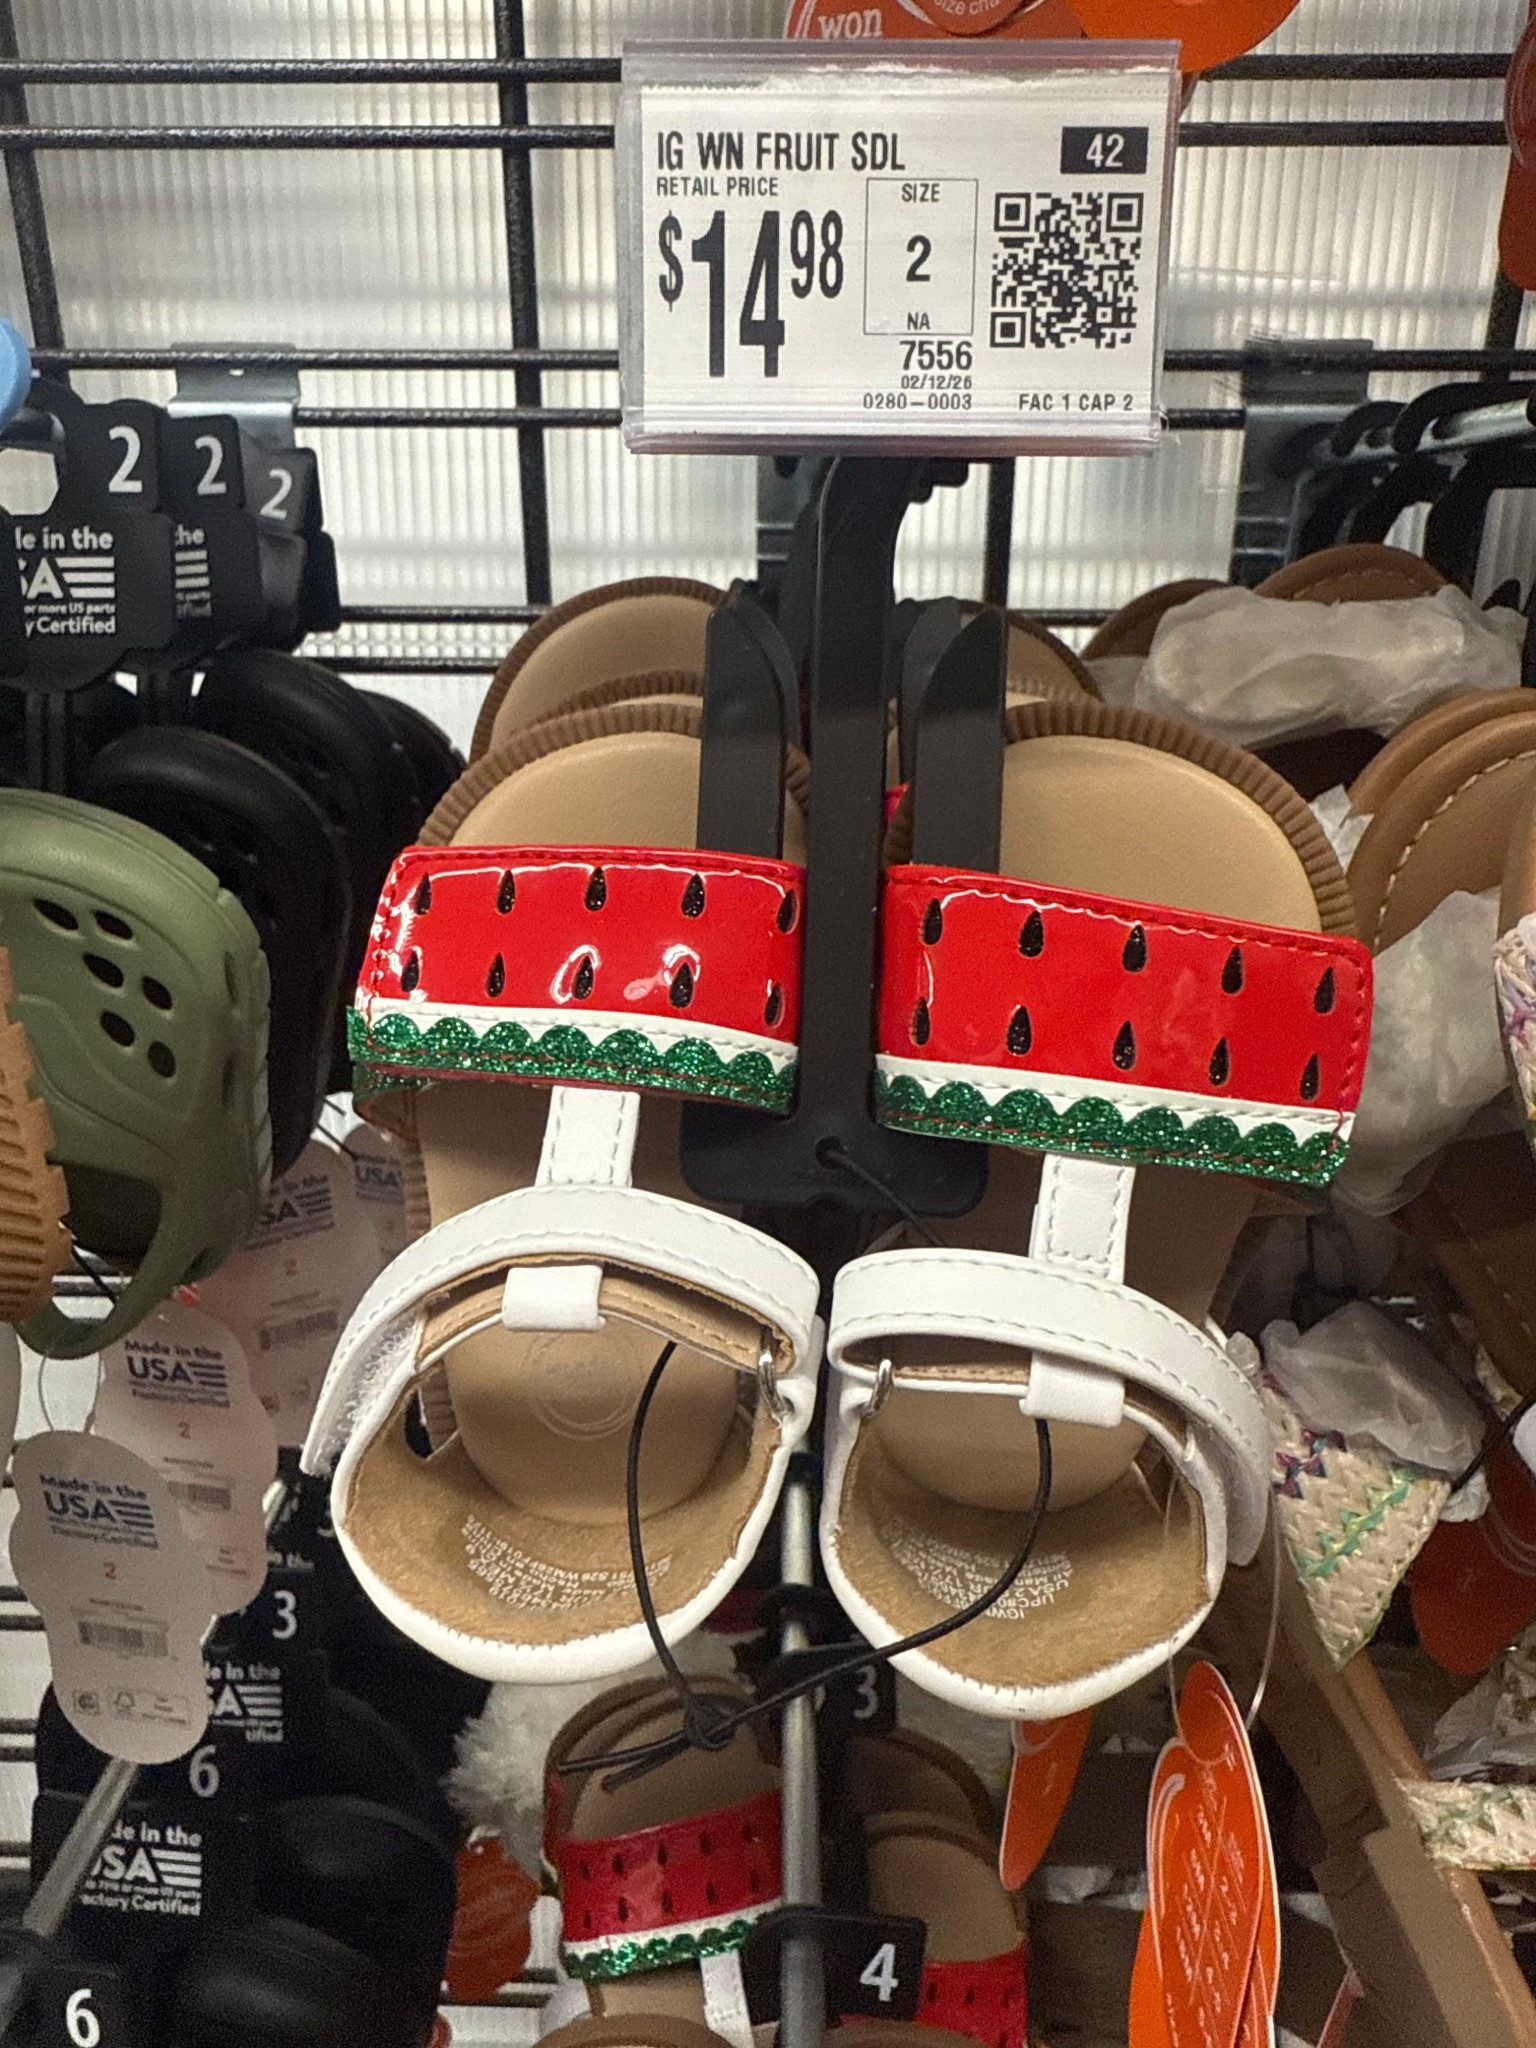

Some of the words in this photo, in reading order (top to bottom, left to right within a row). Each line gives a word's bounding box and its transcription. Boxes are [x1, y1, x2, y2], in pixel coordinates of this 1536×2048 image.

[818, 8, 883, 40] won
[658, 131, 683, 170] IG
[697, 131, 743, 171] WN
[756, 132, 839, 171] FRUIT
[851, 131, 905, 171] SDL
[1085, 135, 1124, 168] 42
[657, 176, 719, 196] RETAIL
[727, 176, 779, 196] PRICE
[901, 183, 940, 203] SIZE
[906, 235, 932, 282] 2
[907, 312, 931, 331] NA
[900, 340, 973, 371] 7556
[1018, 394, 1052, 411] FAC
[1062, 394, 1071, 411] 1
[1079, 394, 1116, 411] CAP
[1123, 394, 1134, 411] 2
[107, 425, 143, 494] 2
[194, 436, 227, 495] 2
[259, 468, 293, 520] 2
[42, 526, 65, 550] in
[71, 525, 114, 550] the
[37, 604, 67, 615] more
[69, 602, 85, 614] US
[36, 615, 116, 635] Certified
[260, 1200, 300, 1226] SA
[127, 1355, 194, 1384] USA
[43, 1490, 117, 1523] USA
[103, 1562, 117, 1580] 2
[272, 1590, 298, 1639] 3
[853, 1665, 879, 1720] 3
[190, 1745, 220, 1798] 6
[141, 1821, 160, 1842] in
[166, 1825, 202, 1848] the
[91, 1845, 157, 1883] SA
[859, 1943, 898, 2002] 4
[66, 1988, 101, 2048] 6
